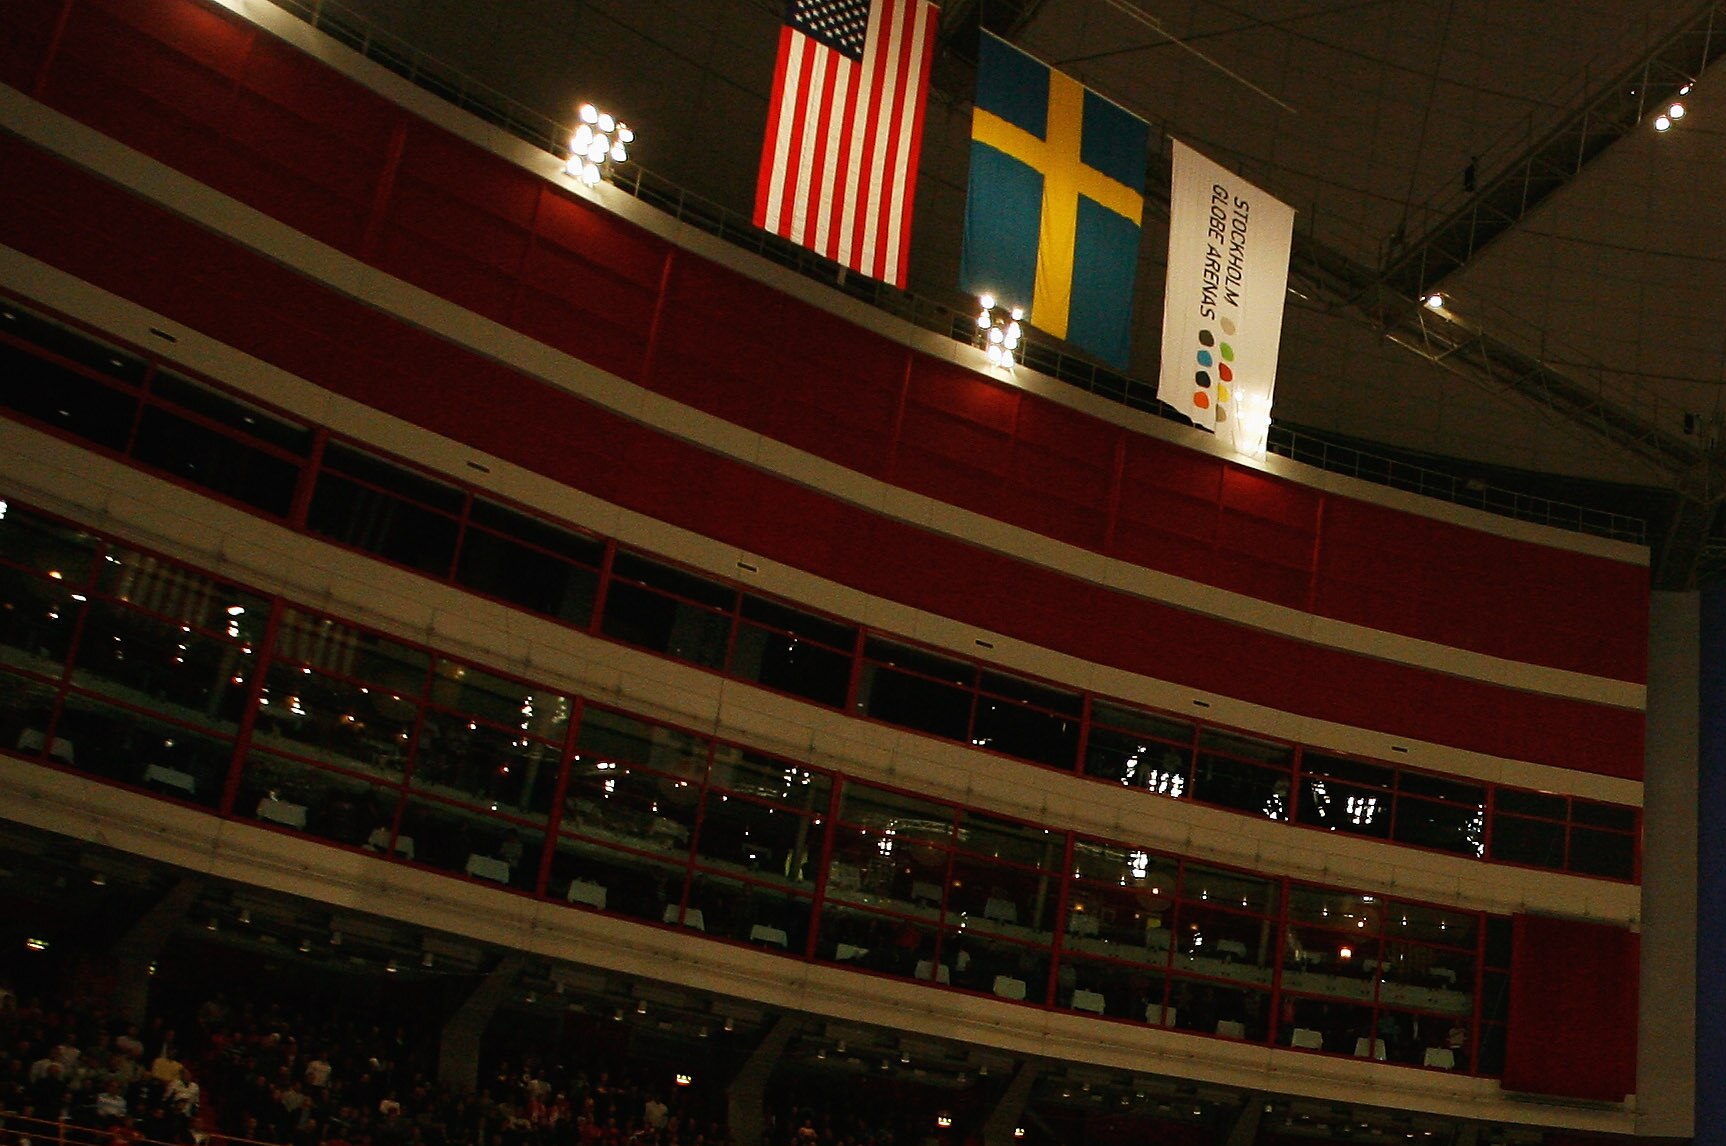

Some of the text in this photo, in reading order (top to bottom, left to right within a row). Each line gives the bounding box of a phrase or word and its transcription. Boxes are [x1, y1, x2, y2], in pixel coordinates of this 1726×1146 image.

[1200, 184, 1228, 321] GLOBE ARENAS
[1224, 196, 1250, 307] STOCKHOLM
